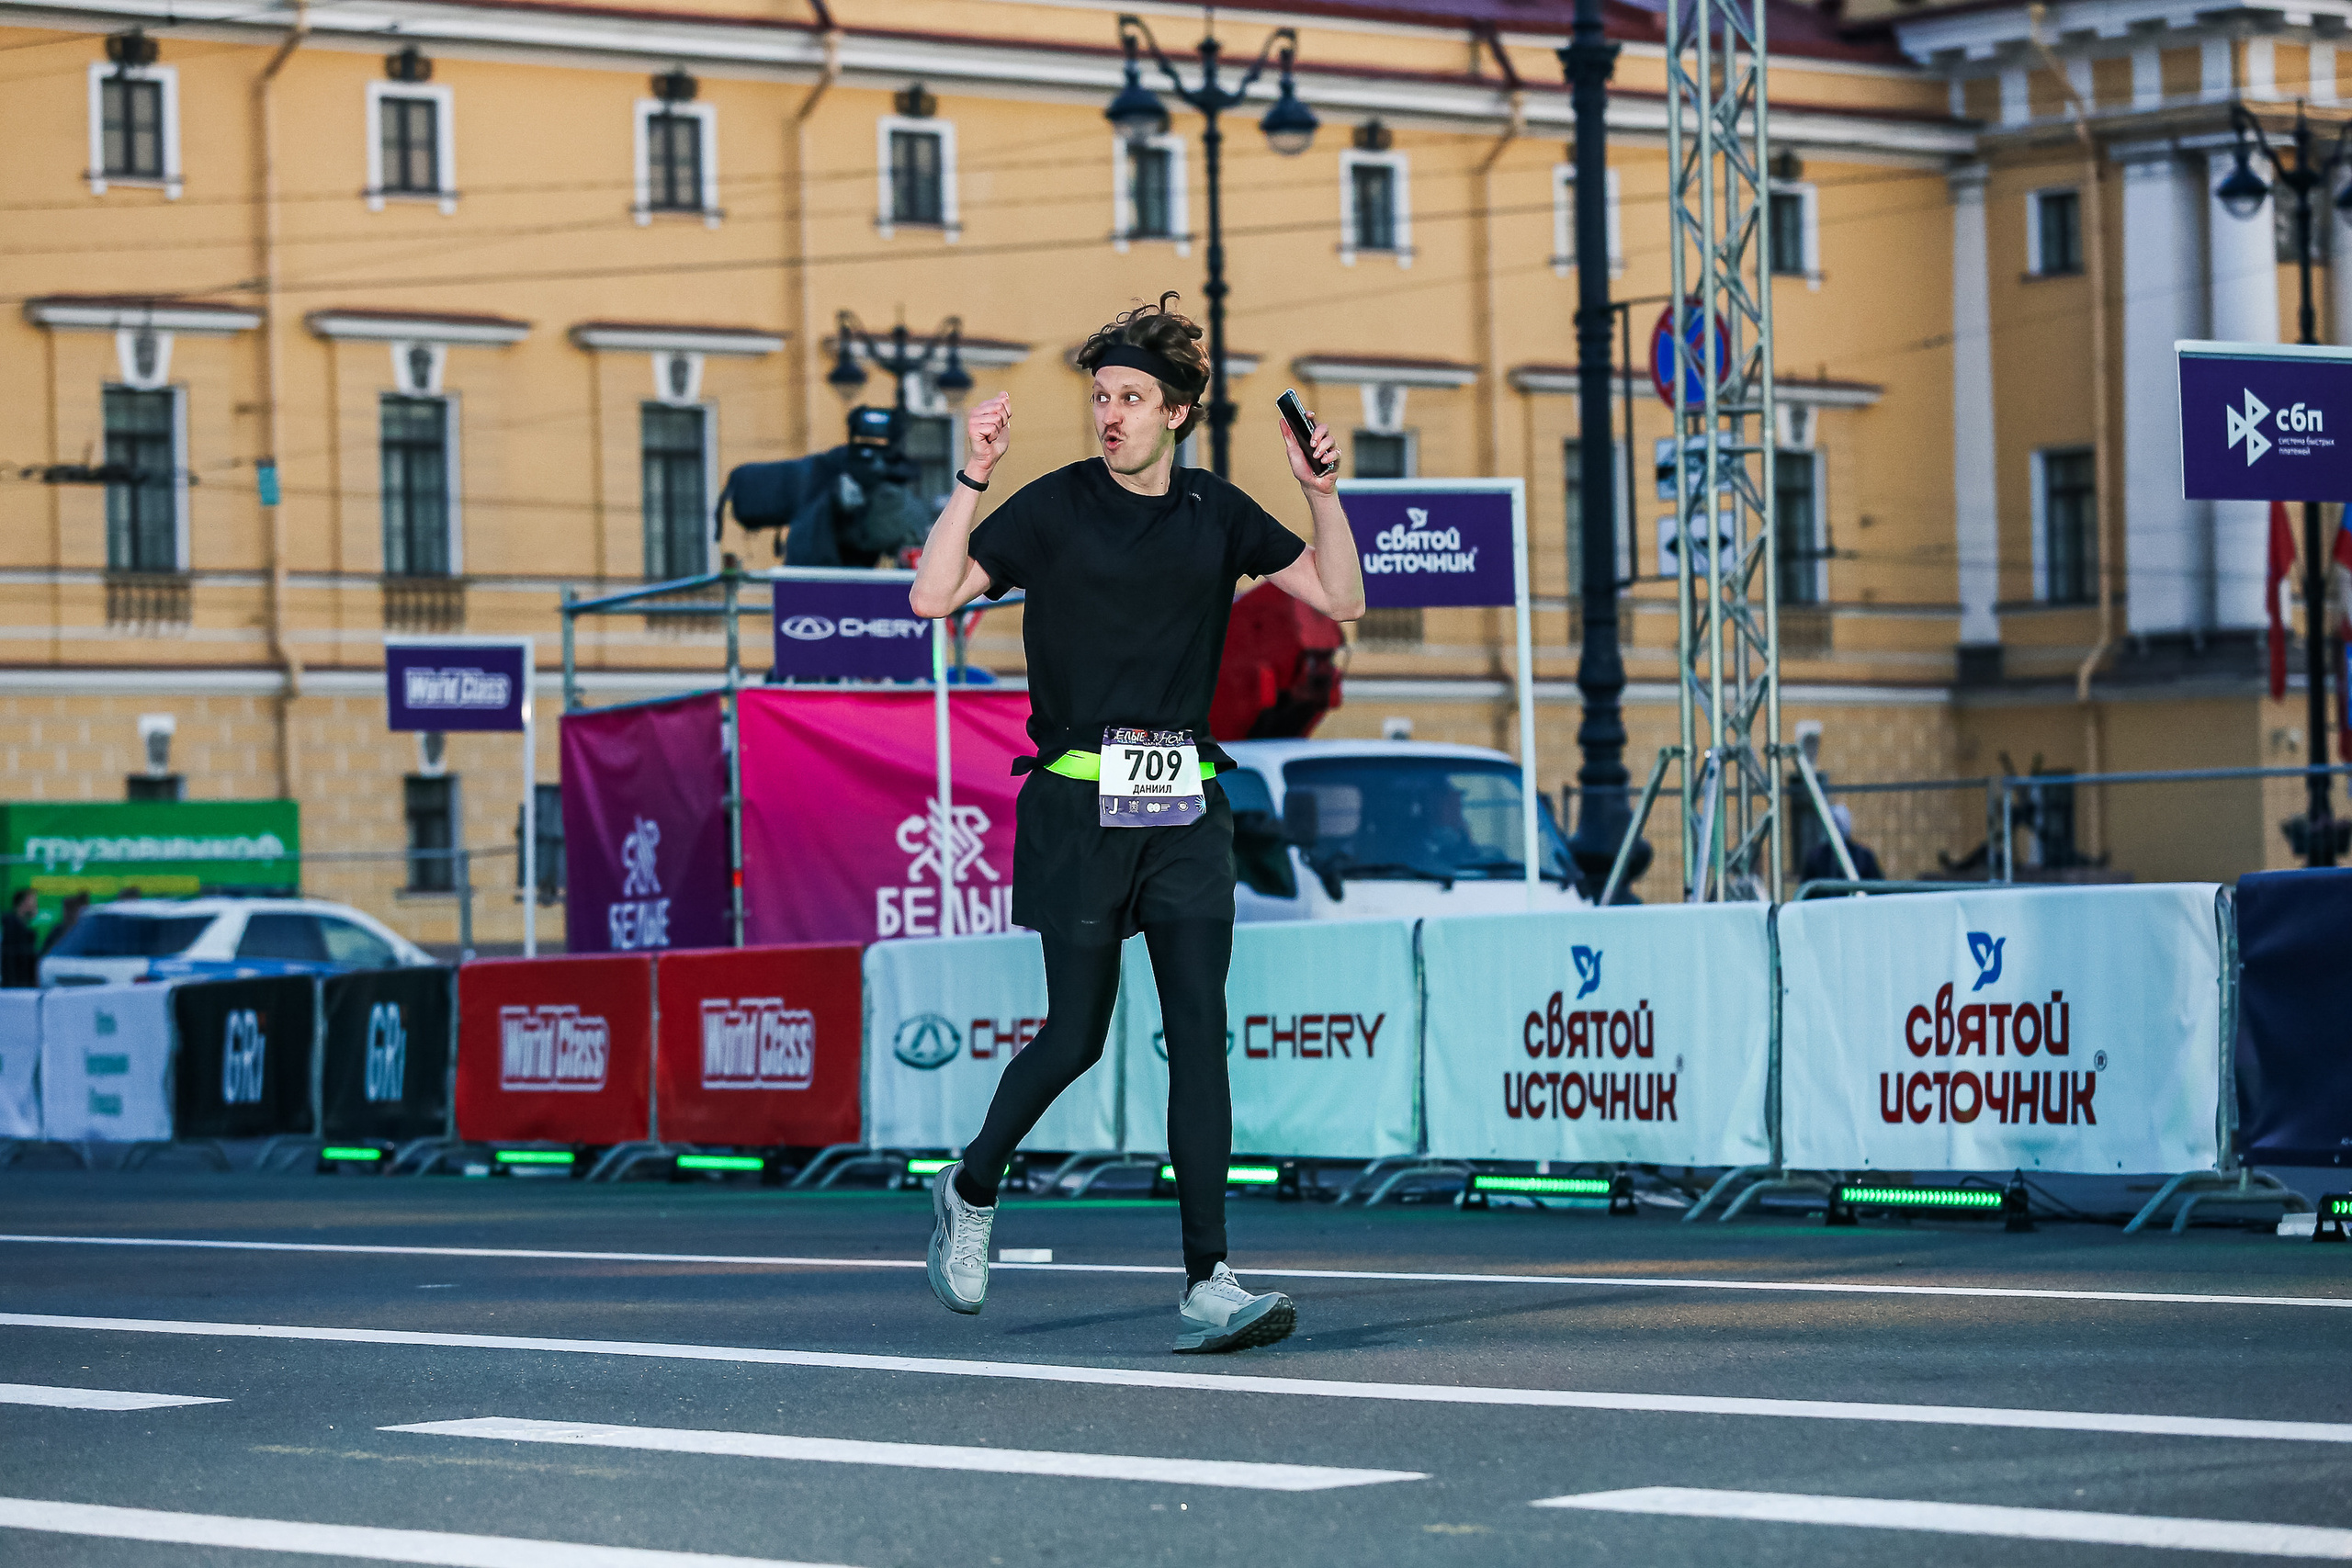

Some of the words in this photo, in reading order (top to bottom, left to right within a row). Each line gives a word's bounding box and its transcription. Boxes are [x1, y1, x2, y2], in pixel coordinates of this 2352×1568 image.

[2276, 402, 2324, 432] сбп
[838, 617, 929, 638] CHERY
[1125, 750, 1182, 781] 709
[1133, 784, 1172, 795] ДАНИИЛ
[876, 886, 1012, 937] БЕЛЫ
[970, 1018, 1047, 1060] CHE
[1245, 1013, 1385, 1059] CHERY
